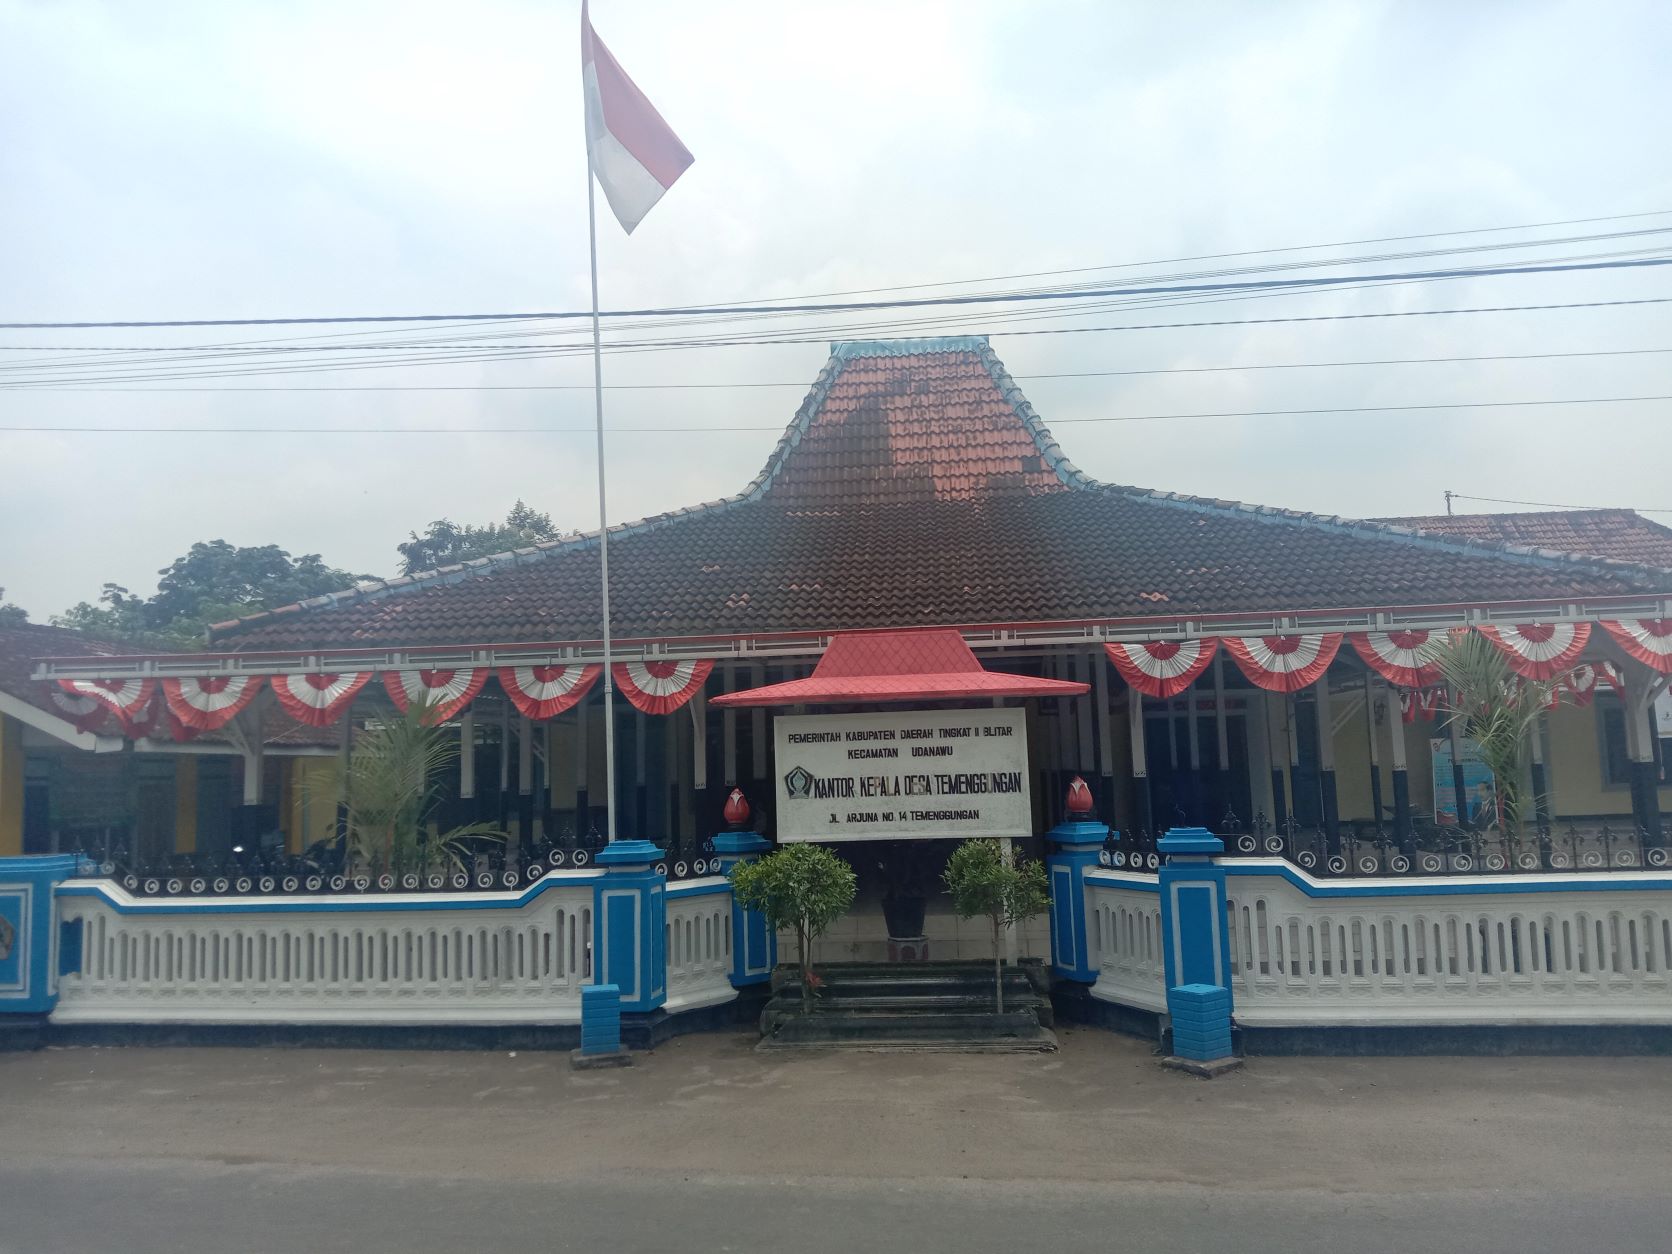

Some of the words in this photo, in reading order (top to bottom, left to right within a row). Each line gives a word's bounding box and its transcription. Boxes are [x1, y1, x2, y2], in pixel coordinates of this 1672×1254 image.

[788, 732, 841, 744] PEMERINTAH
[845, 730, 896, 742] KABUPATEN
[900, 728, 934, 740] DAERAH
[938, 727, 972, 738] TINGKAT
[974, 727, 980, 737] II
[983, 726, 1013, 737] BLITAR
[847, 747, 899, 760] KECAMATAN
[911, 746, 953, 757] UDANAWU
[813, 777, 855, 799] KANTOR
[860, 775, 901, 798] KEPALA
[904, 774, 932, 796] DESA
[934, 772, 1022, 795] TEMENGGUNGAN
[846, 812, 879, 823] ARJUNA
[898, 811, 908, 822] 14
[910, 809, 980, 821] TEMENGGUNGAN
